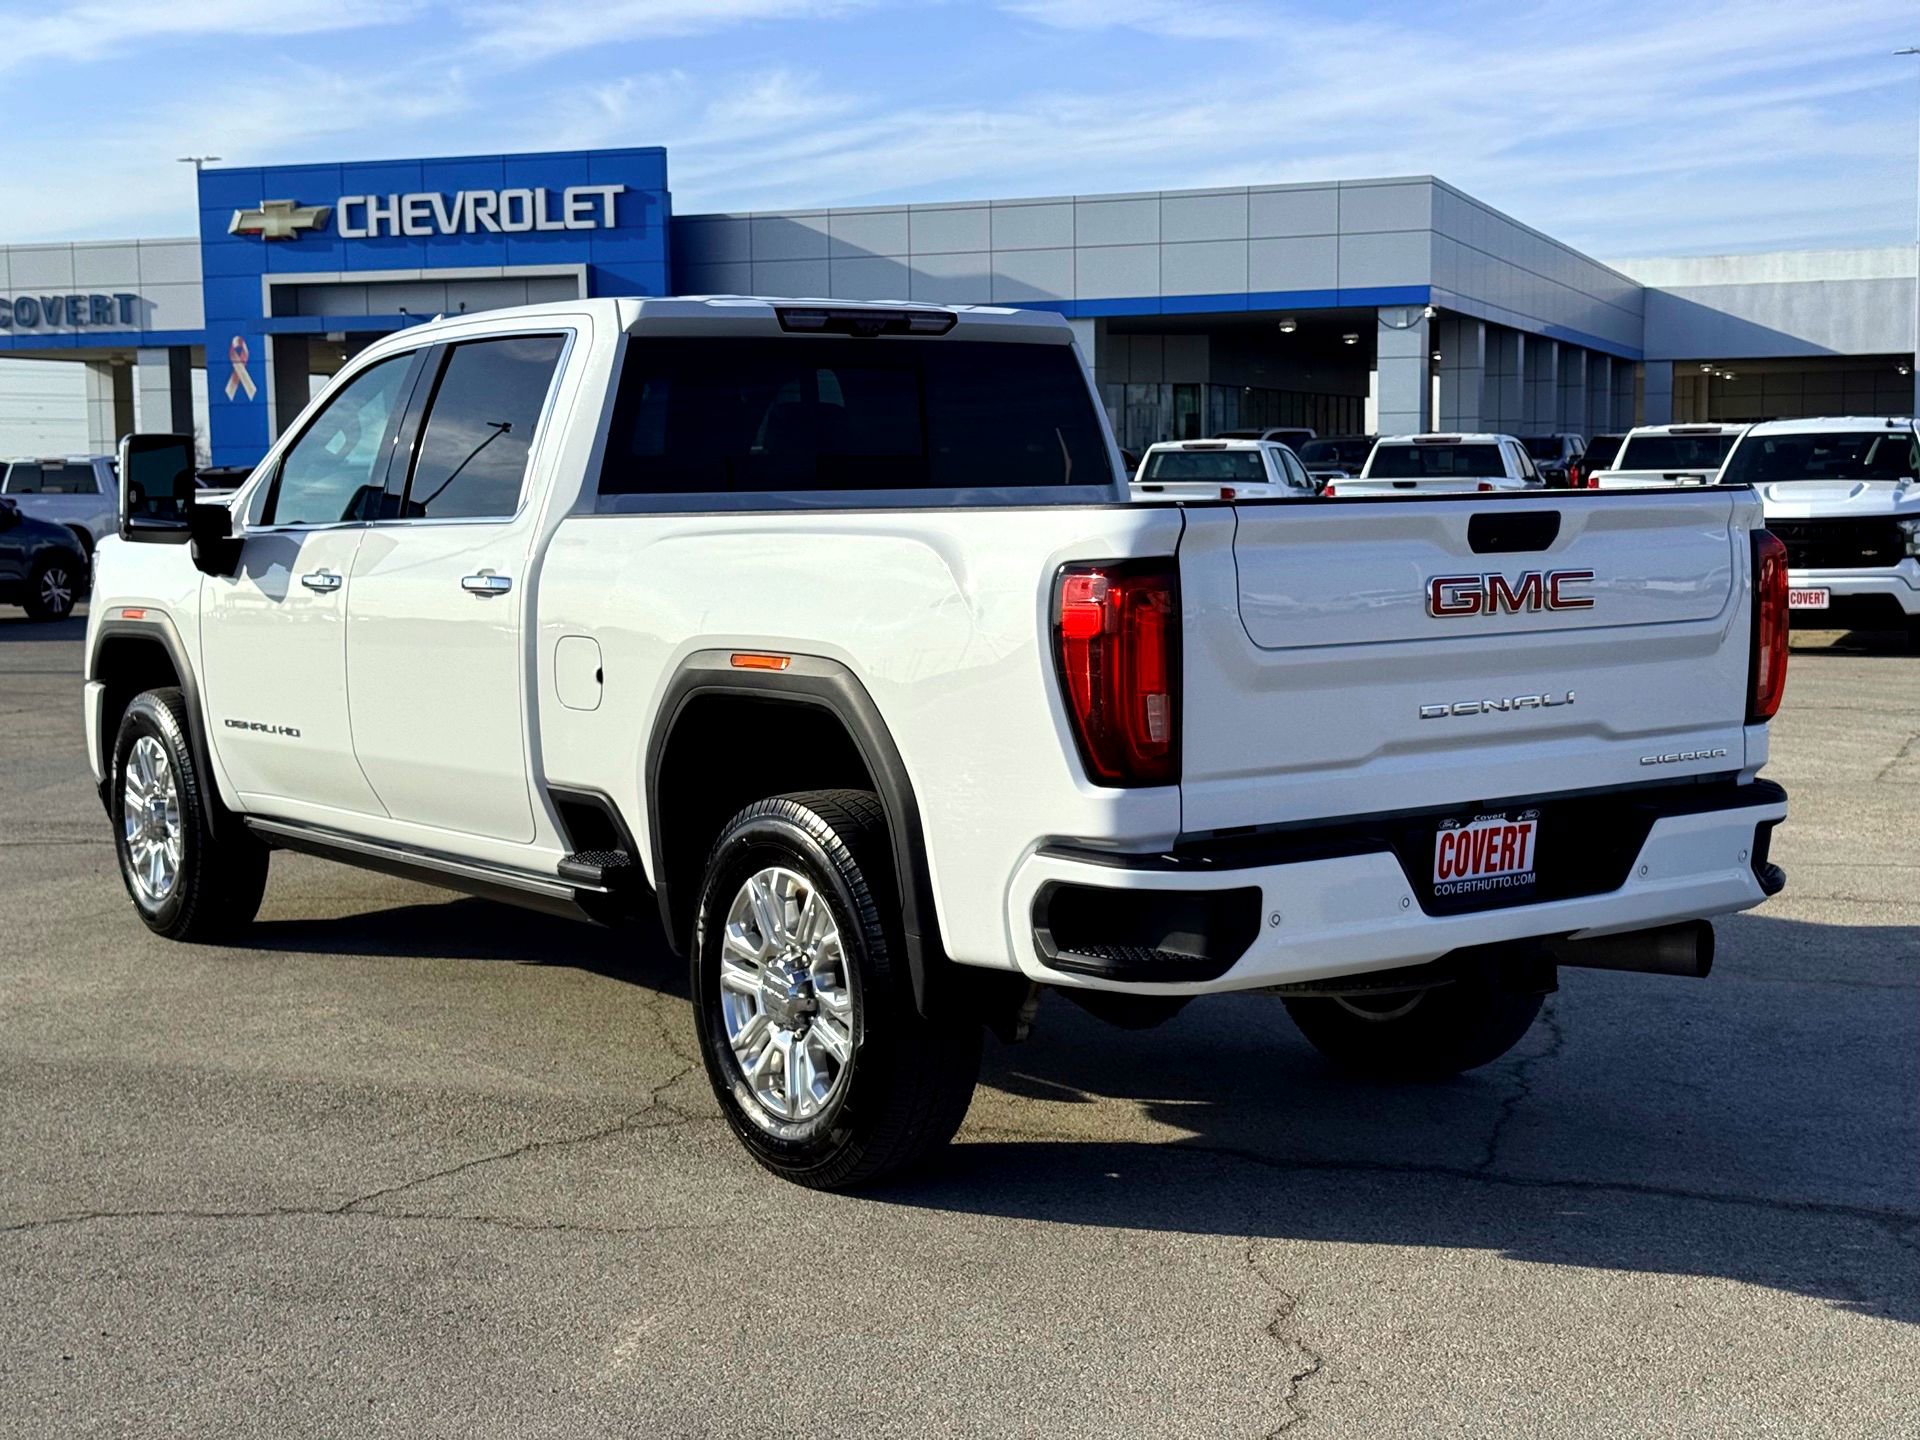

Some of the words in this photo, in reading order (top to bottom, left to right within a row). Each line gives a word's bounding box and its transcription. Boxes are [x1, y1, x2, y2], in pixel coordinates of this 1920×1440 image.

[337, 184, 625, 238] CHEVROLET
[1425, 568, 1596, 618] GMC
[1790, 591, 1826, 605] COVERT
[1419, 690, 1576, 720] DENALI
[1640, 748, 1727, 765] SIERRA
[1473, 812, 1507, 822] Covert
[1438, 824, 1531, 879] COVERT
[1434, 873, 1536, 896] COVERTHUTTO.COM
